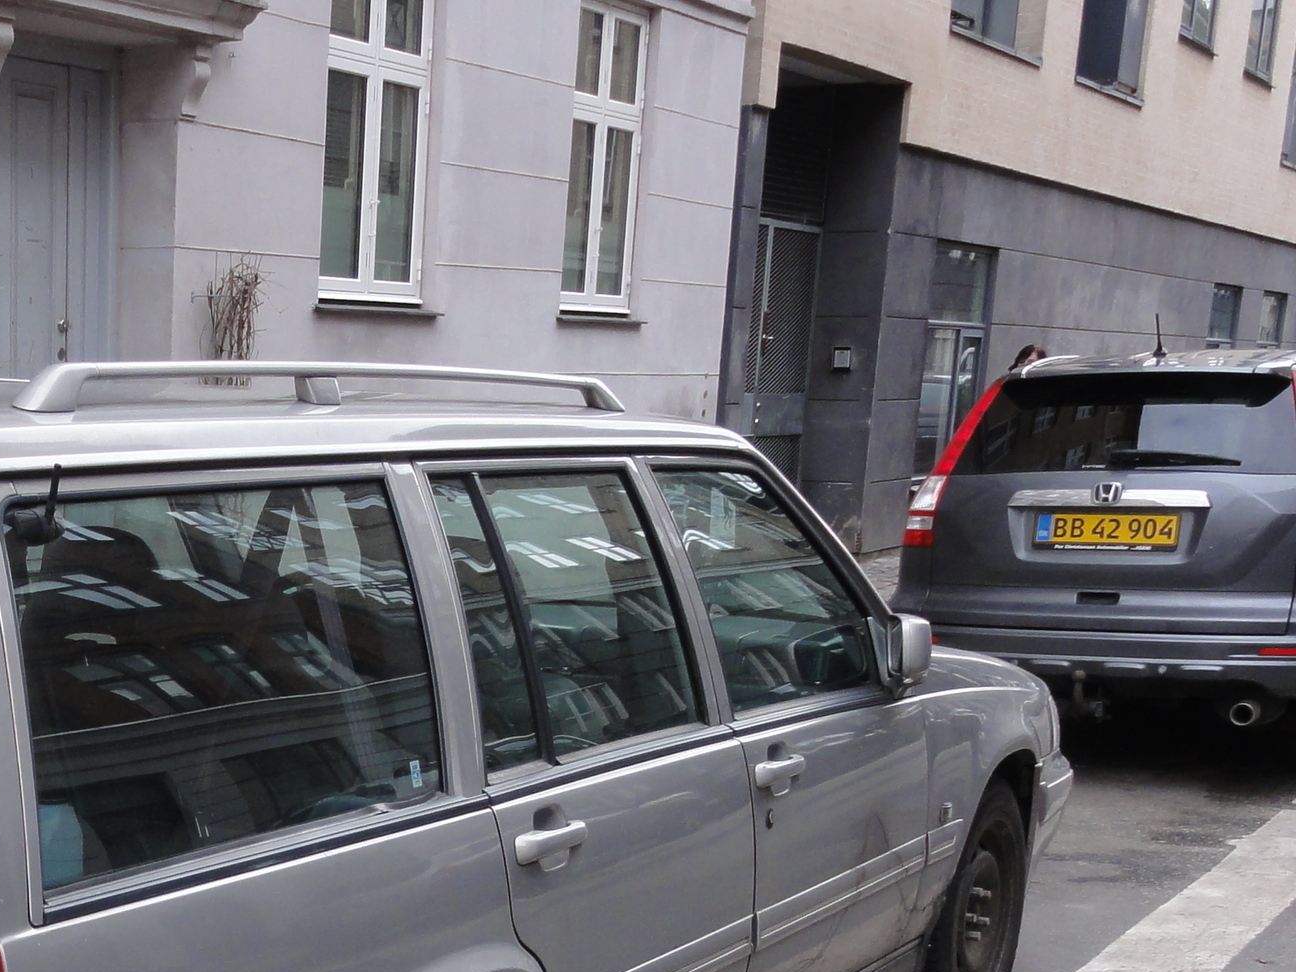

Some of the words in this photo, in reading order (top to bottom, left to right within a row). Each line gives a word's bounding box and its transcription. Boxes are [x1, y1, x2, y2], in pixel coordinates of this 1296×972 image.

[1054, 517, 1084, 538] BB
[1092, 517, 1120, 539] 42
[1128, 518, 1173, 540] 904
